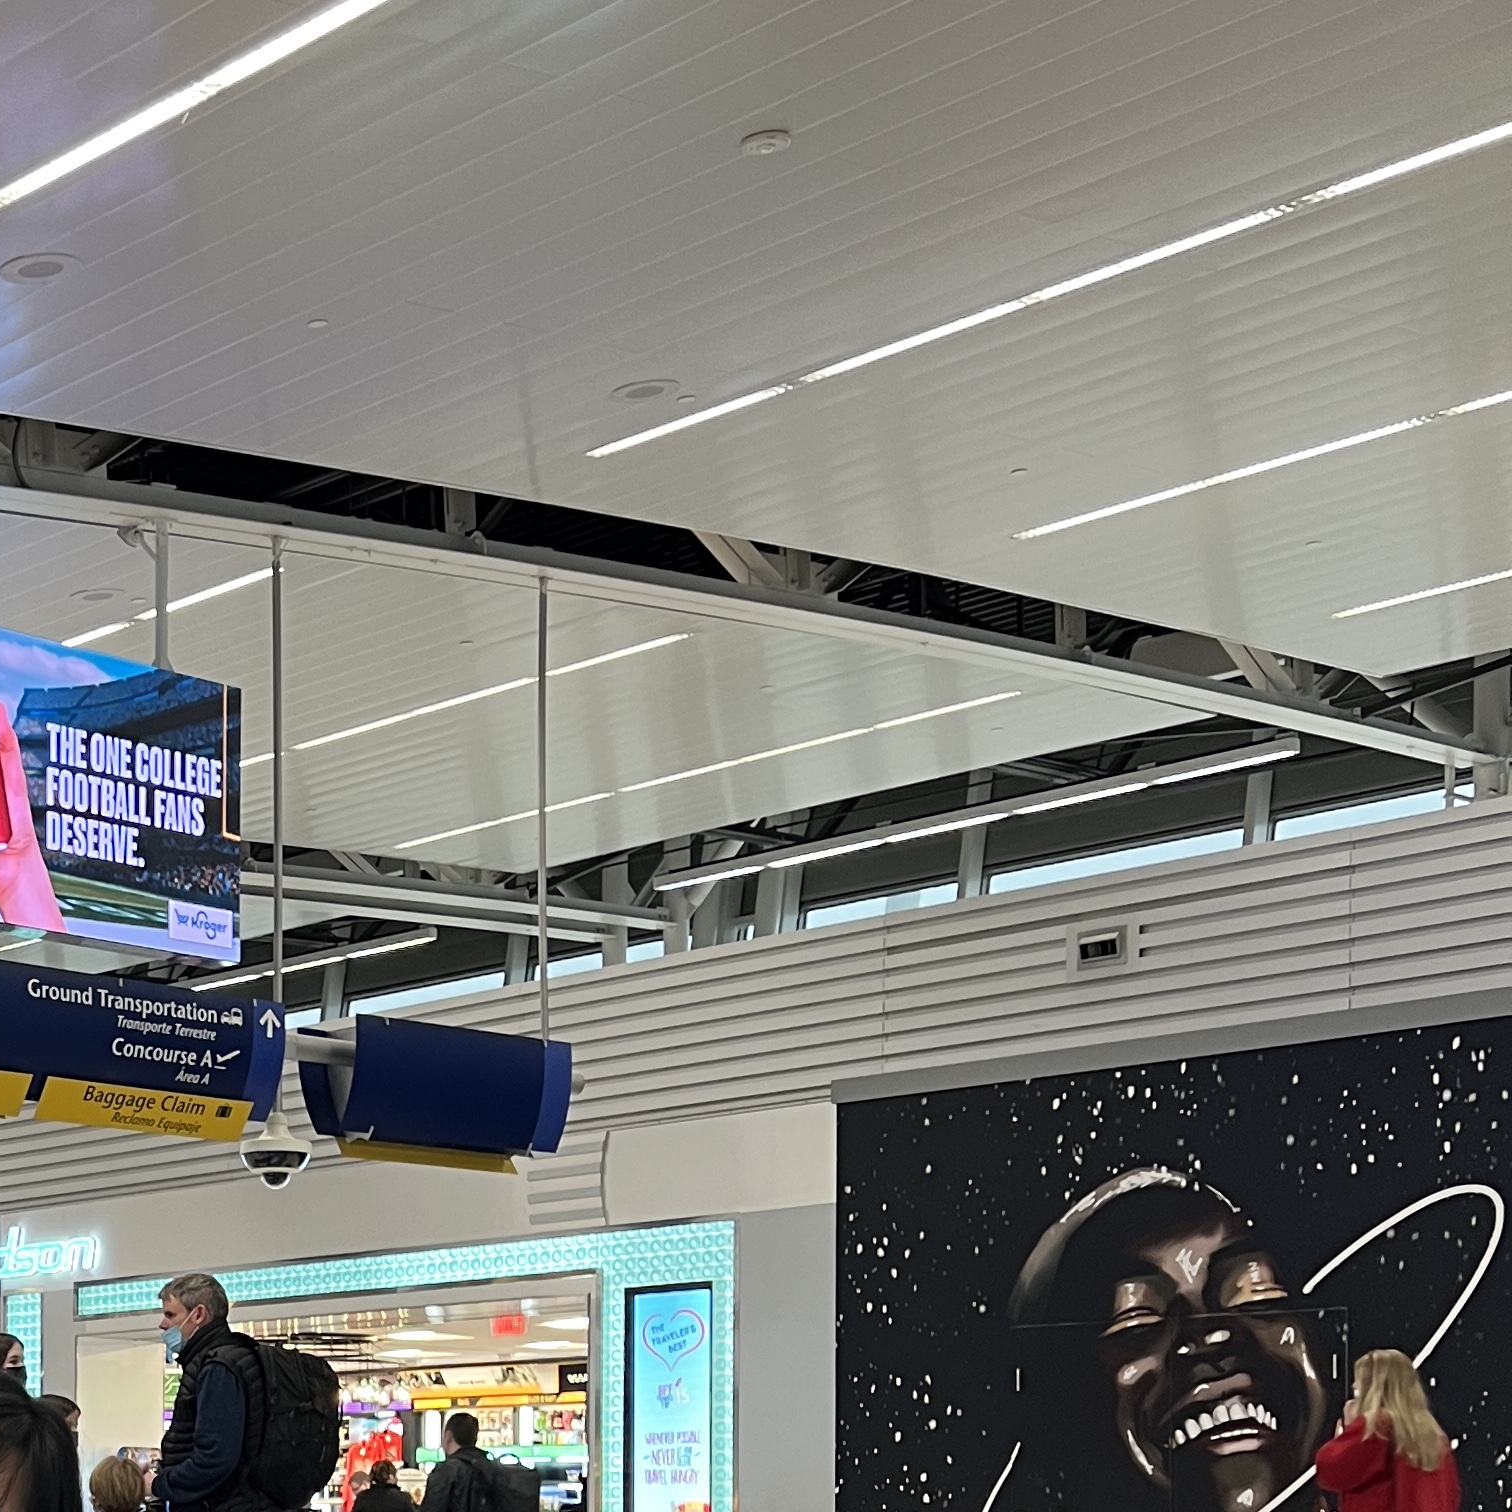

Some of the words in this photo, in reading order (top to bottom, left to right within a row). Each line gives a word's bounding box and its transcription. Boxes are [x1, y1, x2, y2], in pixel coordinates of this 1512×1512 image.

[46, 721, 88, 769] THE
[90, 732, 133, 779] ONE
[135, 742, 222, 799] COLLEGE
[46, 766, 152, 826] FOOTBALL
[153, 788, 206, 837] FANS
[46, 810, 146, 868] DESERVE.
[191, 910, 228, 940] Kroger
[27, 977, 93, 1006] Ground
[97, 988, 218, 1024] Transportation
[117, 1015, 172, 1036] Transporte
[174, 1022, 217, 1041] Terrestre
[111, 1037, 196, 1066] Concourse
[200, 1049, 213, 1069] A
[200, 1072, 210, 1086] A
[83, 1085, 157, 1111] Baggage
[161, 1095, 206, 1116] Claim
[111, 1111, 156, 1128] Reclamo
[158, 1118, 202, 1135] Equipaje
